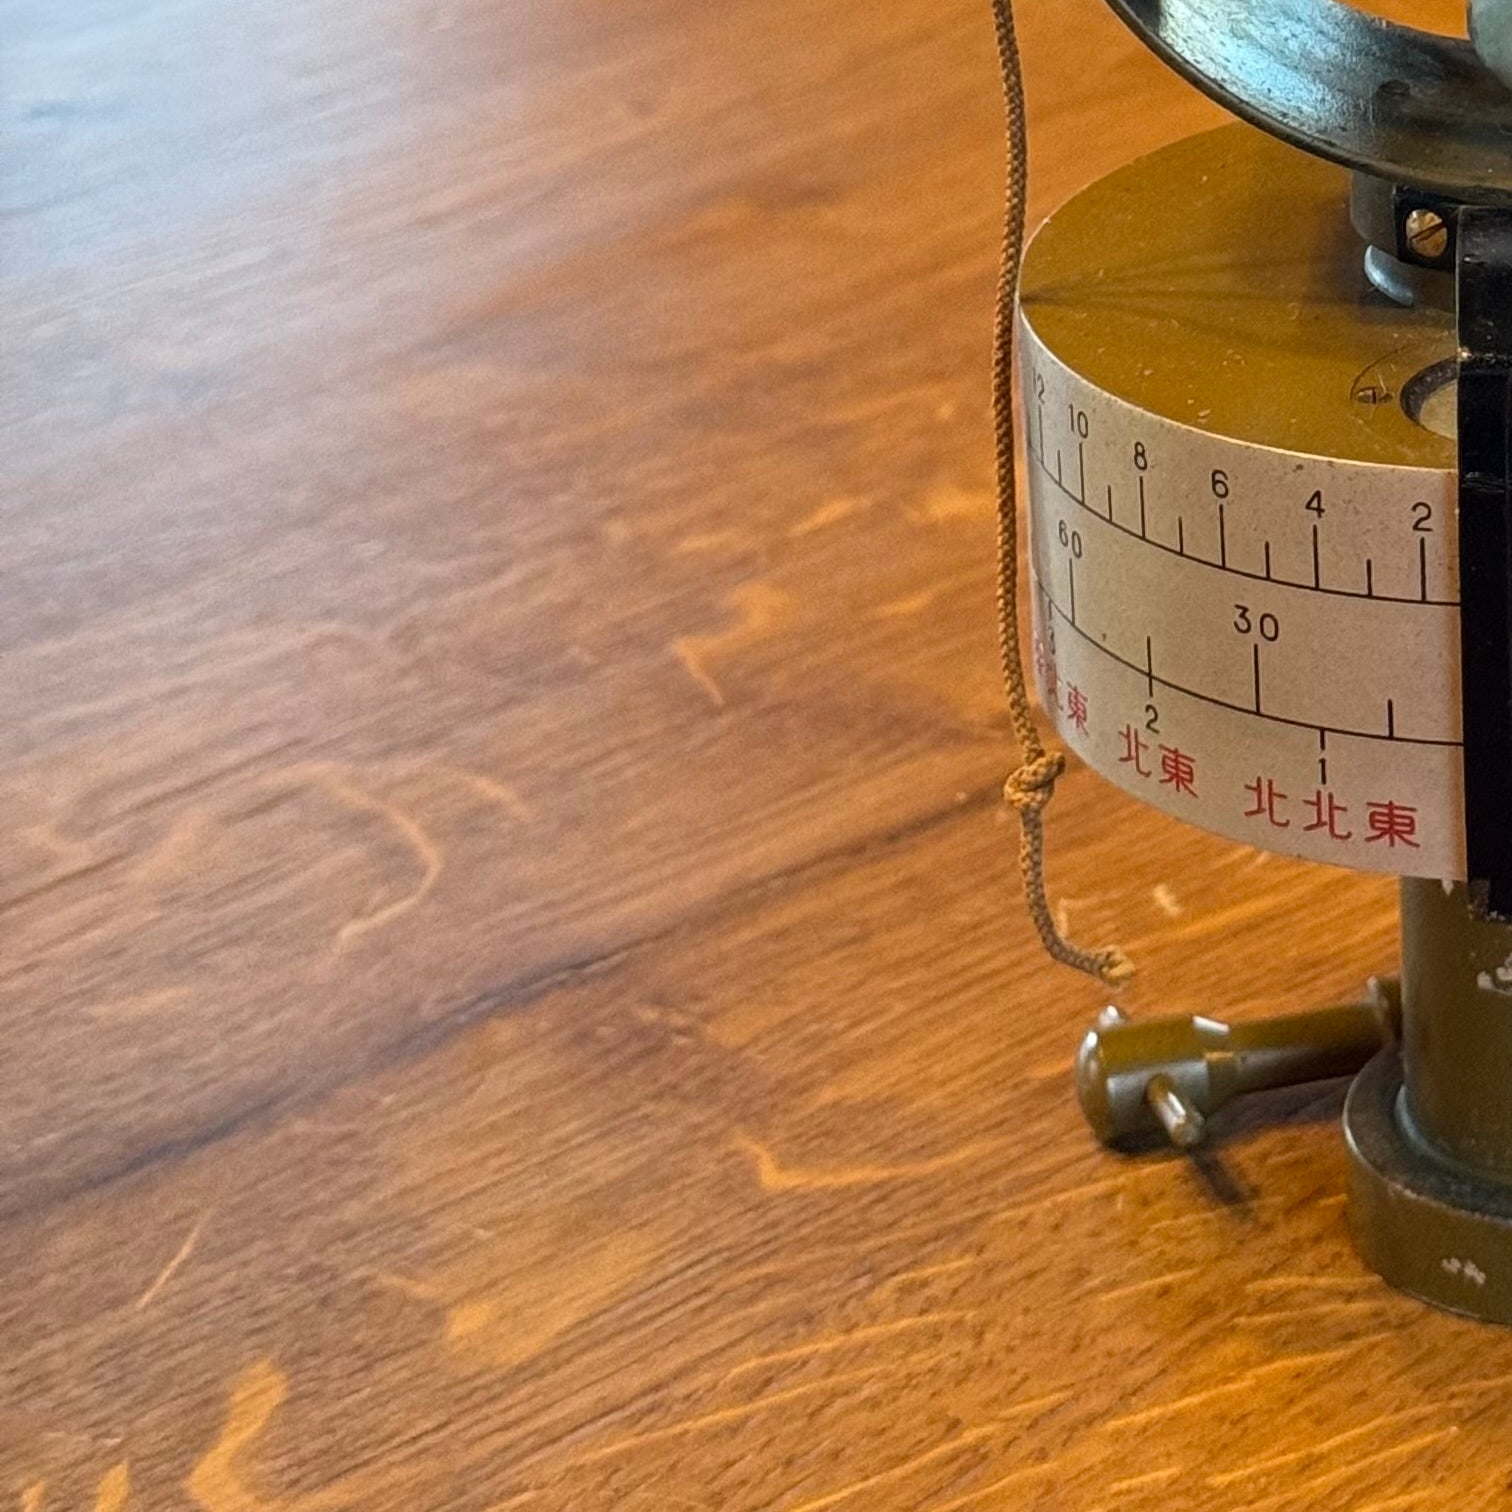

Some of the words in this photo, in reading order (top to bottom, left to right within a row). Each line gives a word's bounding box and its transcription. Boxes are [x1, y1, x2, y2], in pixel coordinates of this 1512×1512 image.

[1069, 403, 1088, 439] 10
[1133, 443, 1148, 471] 8
[1211, 471, 1229, 499] 6
[1305, 491, 1327, 518] 4
[1411, 502, 1433, 533] 2
[1233, 604, 1279, 643] 30
[1118, 725, 1198, 798] 北東
[1244, 776, 1420, 848] 北北東
[1144, 705, 1160, 734] 2
[1318, 758, 1326, 786] 1
